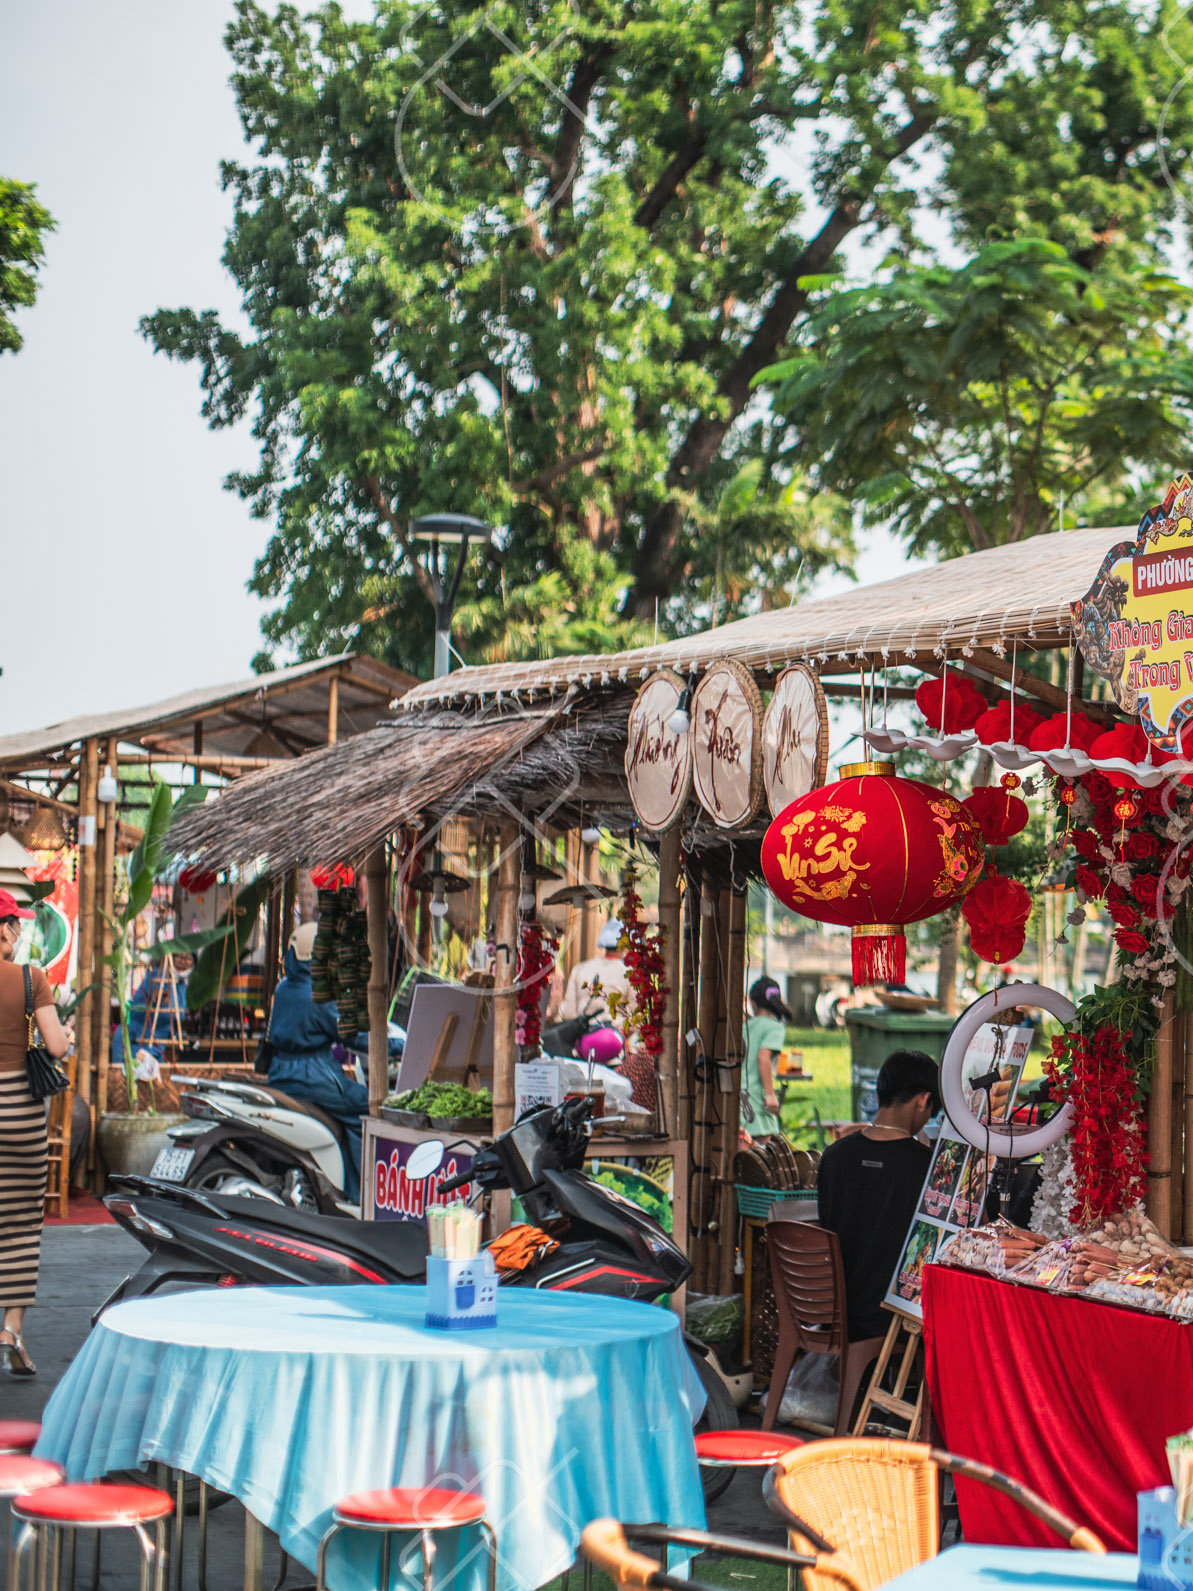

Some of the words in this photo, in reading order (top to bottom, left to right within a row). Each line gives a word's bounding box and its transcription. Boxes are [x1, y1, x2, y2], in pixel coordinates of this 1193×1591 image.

[1108, 619, 1163, 654] Không
[1129, 659, 1181, 692] Trong
[376, 1148, 426, 1219] BÁNH
